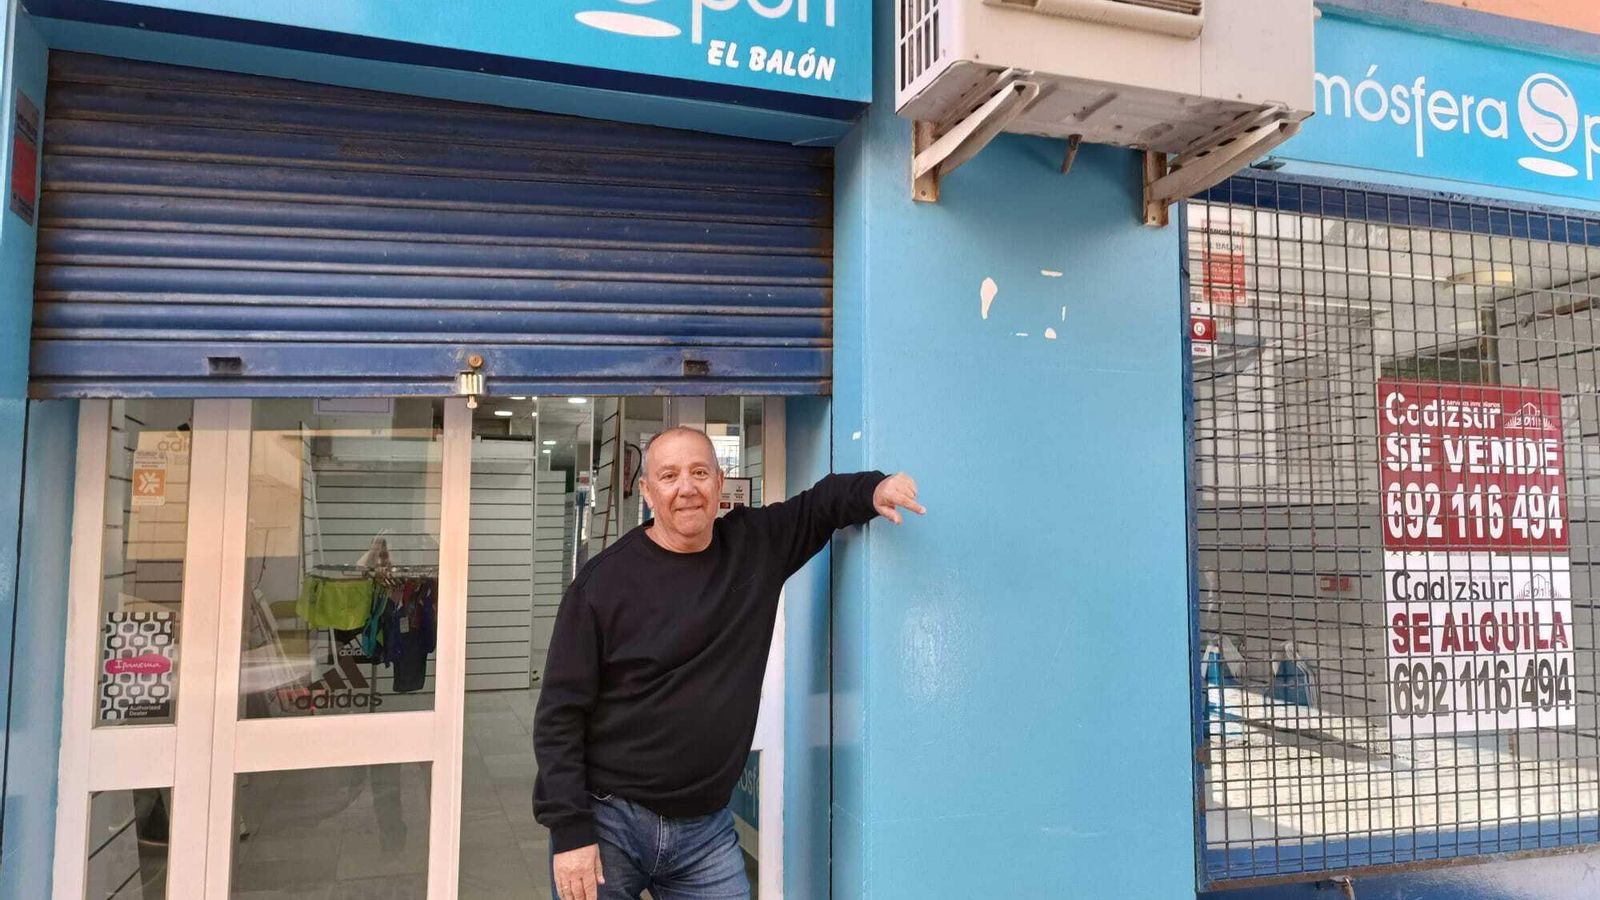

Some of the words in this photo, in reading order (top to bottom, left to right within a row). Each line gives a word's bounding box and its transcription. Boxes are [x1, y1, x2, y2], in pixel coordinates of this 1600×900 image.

[707, 39, 739, 69] EL
[748, 45, 836, 82] BALÓN
[1314, 64, 1509, 158] mósfera
[1385, 391, 1501, 429] Cadizsur
[1386, 432, 1433, 473] SE
[1443, 434, 1560, 476] VENDE
[1387, 482, 1443, 539] 692
[1452, 483, 1504, 540] 116
[1512, 484, 1563, 540] 494
[1392, 570, 1510, 601] Cadzsur
[1392, 612, 1431, 654] SE
[1441, 611, 1569, 654] ALQUILA
[295, 687, 383, 710] adidas
[1394, 661, 1449, 720] 692
[1460, 659, 1512, 716] 116
[1521, 657, 1572, 713] 494
